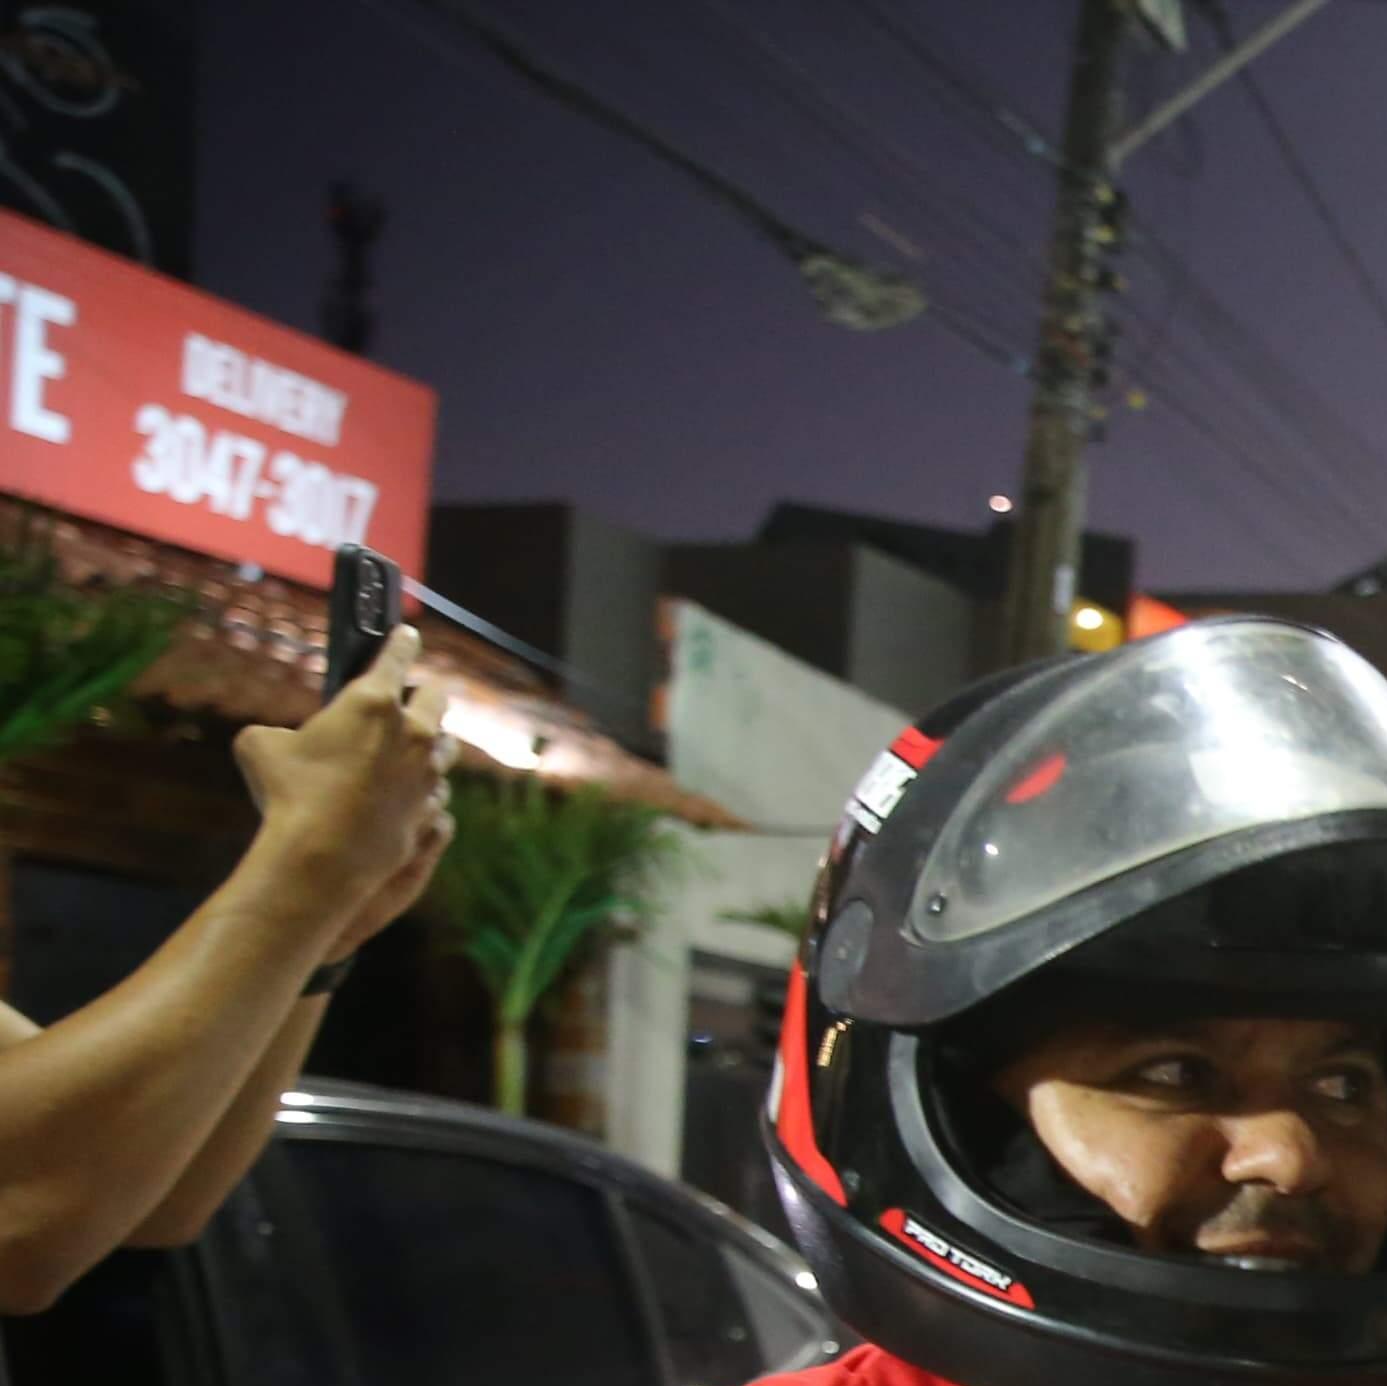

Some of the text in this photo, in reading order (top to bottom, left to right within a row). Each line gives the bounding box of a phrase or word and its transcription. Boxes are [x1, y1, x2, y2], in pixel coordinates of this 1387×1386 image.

[181, 331, 348, 447] DELIVERY
[904, 1218, 1012, 1291] PRO TORK
